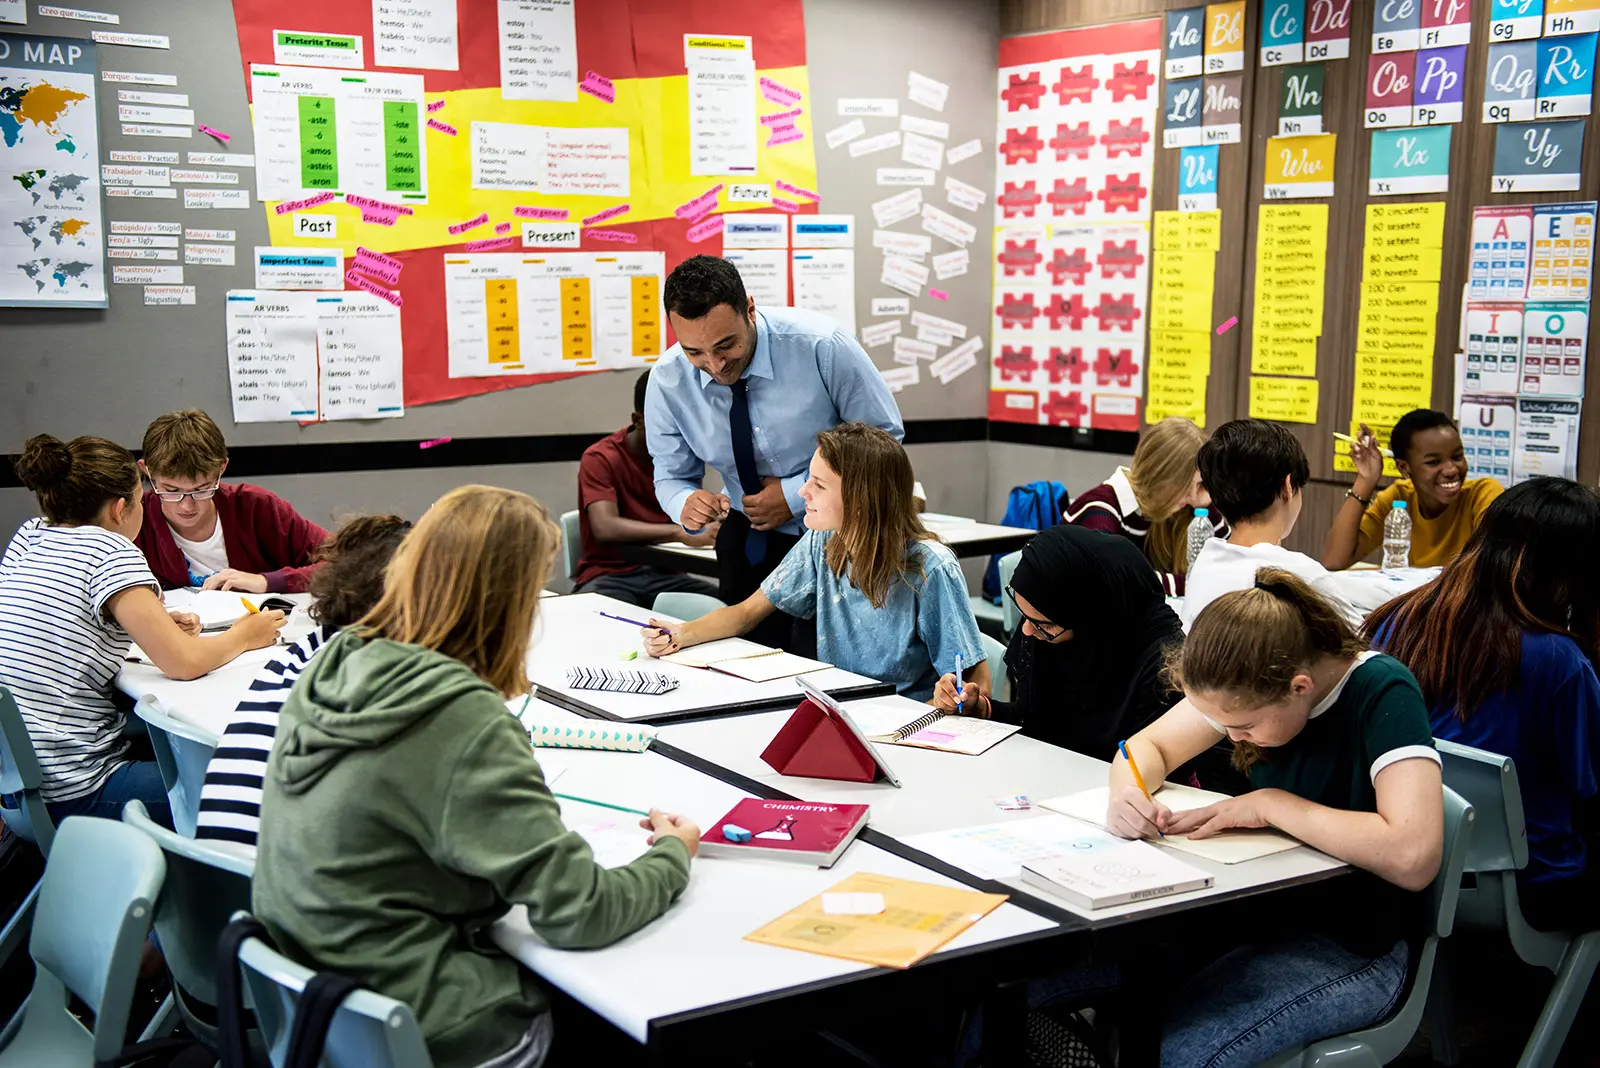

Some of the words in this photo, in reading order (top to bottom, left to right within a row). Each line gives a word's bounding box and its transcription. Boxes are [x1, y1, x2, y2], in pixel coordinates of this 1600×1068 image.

[40, 6, 59, 15] Creo
[1310, 0, 1350, 34] Dd
[1270, 4, 1298, 38] Cc
[1552, 18, 1574, 32] Hh
[1170, 15, 1200, 50] Aa
[1212, 11, 1241, 47] Bb
[1494, 24, 1514, 40] Gg
[285, 36, 324, 46] Preterite
[326, 38, 349, 48] Tense
[1378, 37, 1394, 49] Ee
[1426, 31, 1440, 45] Ff
[24, 41, 82, 66] MAP
[1266, 51, 1282, 62] Cc
[1310, 45, 1328, 58] Dd
[1209, 59, 1224, 70] Bb
[1544, 45, 1587, 85] Rr
[103, 72, 130, 81] Porque
[1372, 60, 1410, 98] Oo
[1420, 56, 1458, 101] Pp
[1490, 54, 1535, 99] Qq
[1285, 74, 1322, 110] Nn
[1168, 88, 1199, 122] Ll
[1203, 84, 1241, 114] Mm
[1540, 100, 1557, 113] Rr
[308, 116, 328, 125] -aste
[1368, 111, 1386, 124] Oo
[1418, 108, 1437, 125] Pp
[1489, 106, 1510, 122] Qq
[1284, 122, 1301, 132] Nn
[306, 148, 332, 156] -amos
[1394, 136, 1429, 168] Xx
[1523, 128, 1562, 168] Yy
[112, 152, 142, 161] Practico
[148, 153, 179, 163] Practical
[1280, 148, 1324, 178] Ww
[102, 167, 143, 176] Trabajador
[307, 162, 333, 172] -asteis
[102, 178, 134, 186] working
[171, 172, 209, 180] Gracioso/a
[309, 178, 332, 186] -aron
[1377, 182, 1391, 192] Xx
[1498, 178, 1514, 192] Yy
[186, 190, 215, 199] Guapo/a
[733, 186, 768, 198] Future
[1269, 188, 1288, 198] Ww
[186, 200, 214, 208] Looking
[276, 206, 285, 214] El
[286, 202, 301, 212] año
[304, 192, 334, 208] pasado
[346, 194, 355, 203] El
[356, 196, 367, 206] fin
[368, 200, 380, 208] de
[381, 203, 414, 216] semana
[1373, 208, 1384, 217] 50
[300, 218, 332, 232] Past
[362, 213, 394, 226] pasado
[158, 224, 180, 233] Stupid
[1492, 219, 1509, 240] A
[1548, 216, 1561, 238] E
[186, 230, 210, 238] Malo/a
[528, 230, 576, 242] Present
[138, 237, 154, 245] Ugly
[108, 250, 138, 258] Tonto/a
[144, 250, 159, 259] Silly
[186, 255, 222, 264] Dangerous
[357, 247, 387, 264] Cuando
[260, 257, 299, 266] Imperfect
[114, 266, 162, 274] Desastroso/a
[352, 261, 398, 283] pequeño/a
[115, 275, 152, 283] Disastrous
[144, 286, 189, 295] Asqueroso/a
[360, 279, 402, 307] pequeño/a
[1369, 284, 1385, 293] 100
[144, 296, 182, 304] Disgusting
[1488, 314, 1500, 334] I
[1545, 314, 1565, 335] O
[263, 394, 280, 402] They
[1549, 403, 1577, 413] Checklist
[1480, 408, 1494, 427] U
[763, 802, 838, 813] CHEMISTRY
[1129, 888, 1141, 900] ART
[1141, 884, 1176, 898] EDUCATION
